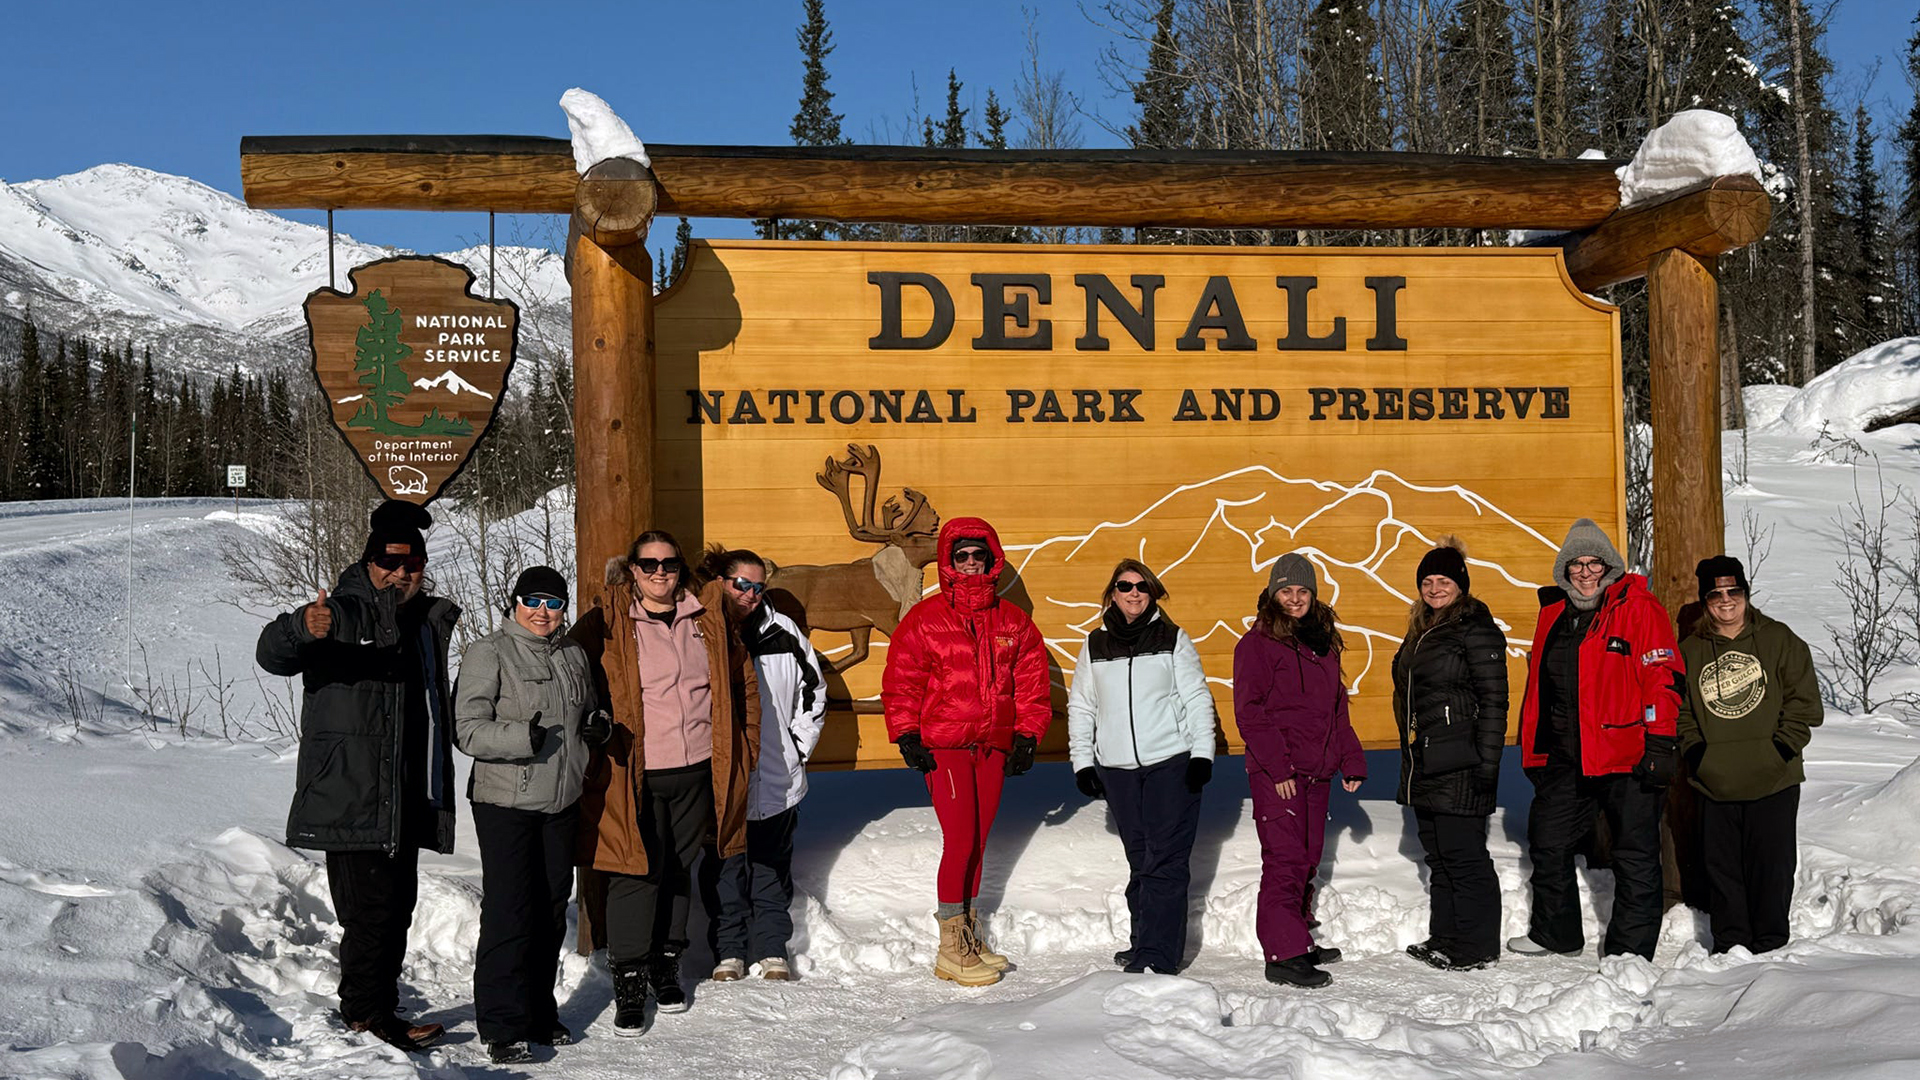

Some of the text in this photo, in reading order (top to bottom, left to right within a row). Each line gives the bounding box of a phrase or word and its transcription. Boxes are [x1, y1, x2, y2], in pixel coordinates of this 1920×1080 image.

[867, 271, 1407, 351] DENALI
[416, 316, 507, 328] NATIONAL
[438, 333, 486, 346] PARK
[424, 350, 501, 362] SERVICE
[686, 386, 1570, 425] NATIONAL PARK AND PRESERVE
[375, 440, 452, 451] Department
[368, 452, 459, 462] of the Interior
[230, 476, 245, 485] 35
[1731, 665, 1759, 685] GULCH
